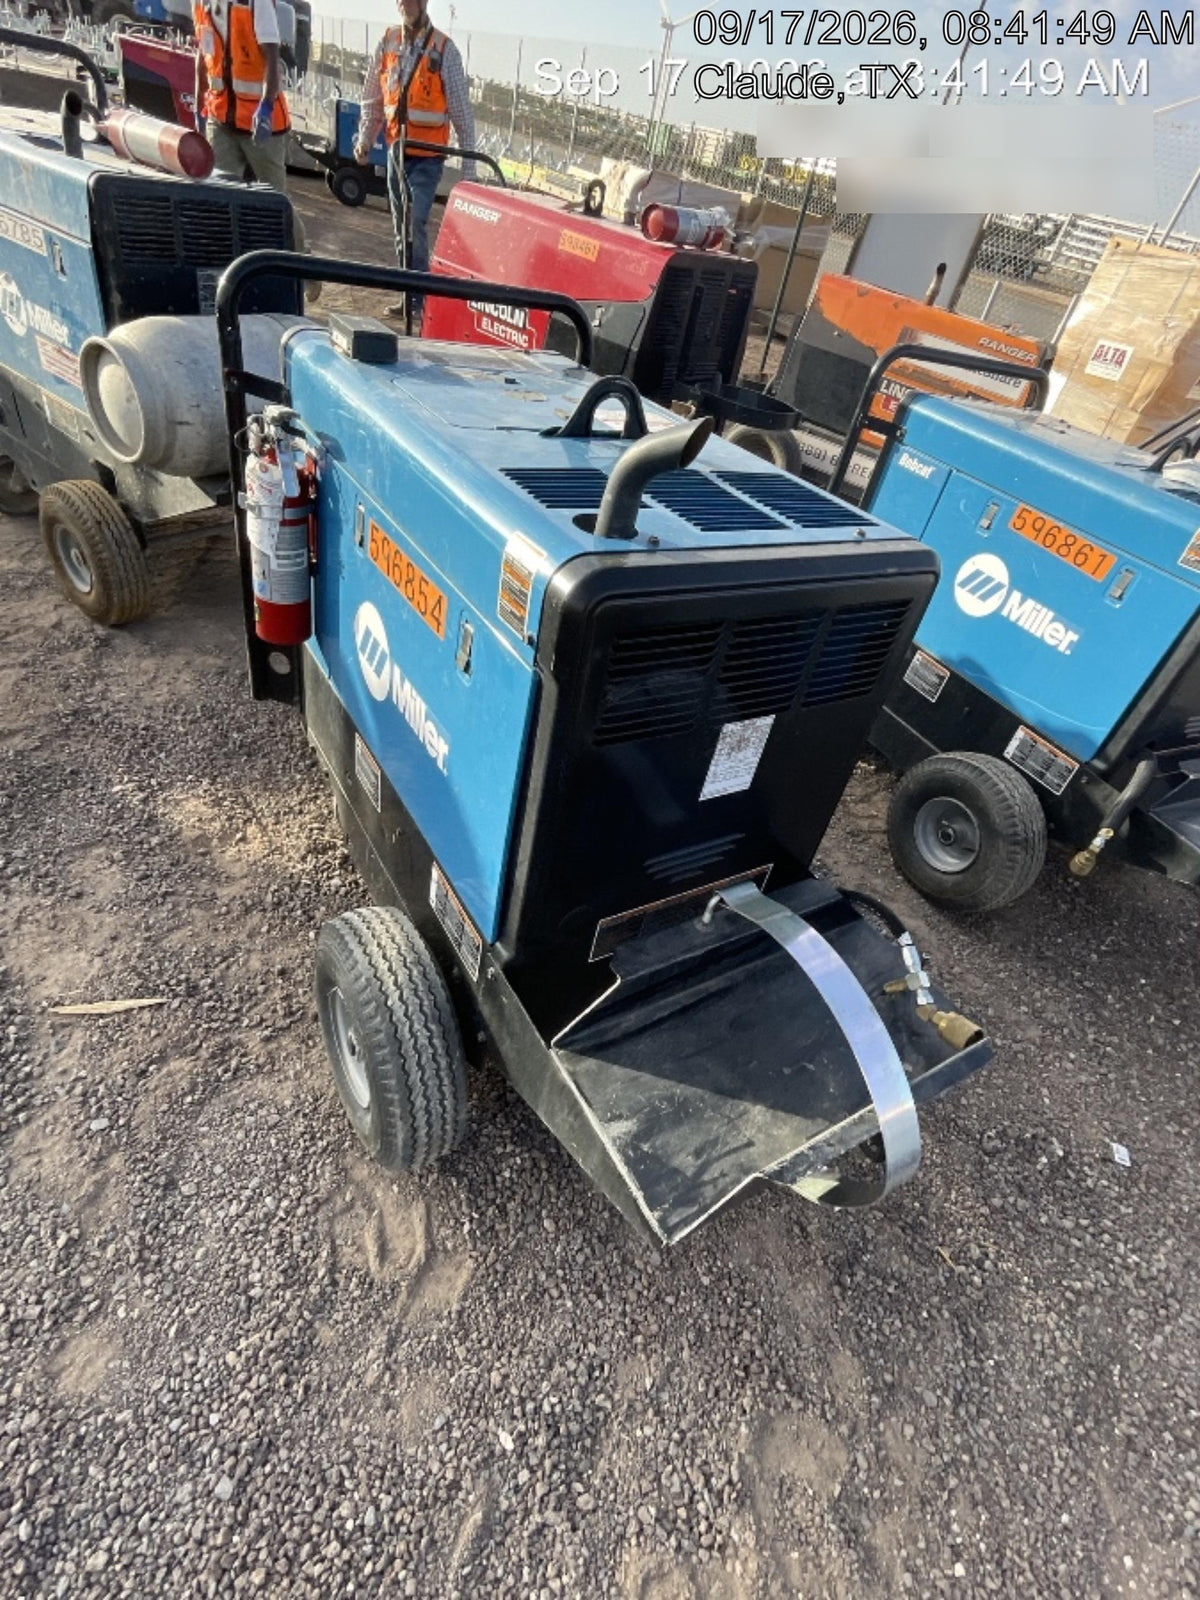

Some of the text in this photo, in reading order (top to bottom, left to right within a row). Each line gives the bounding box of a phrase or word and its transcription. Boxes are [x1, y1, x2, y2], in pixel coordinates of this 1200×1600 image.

[453, 199, 500, 225] RANGER
[481, 316, 529, 348] ELECTRIC
[979, 337, 1037, 363] RANGER
[1091, 344, 1128, 368] ALTA
[898, 452, 934, 479] Bobcat
[1012, 507, 1109, 576] 596861
[369, 522, 443, 635] 596854
